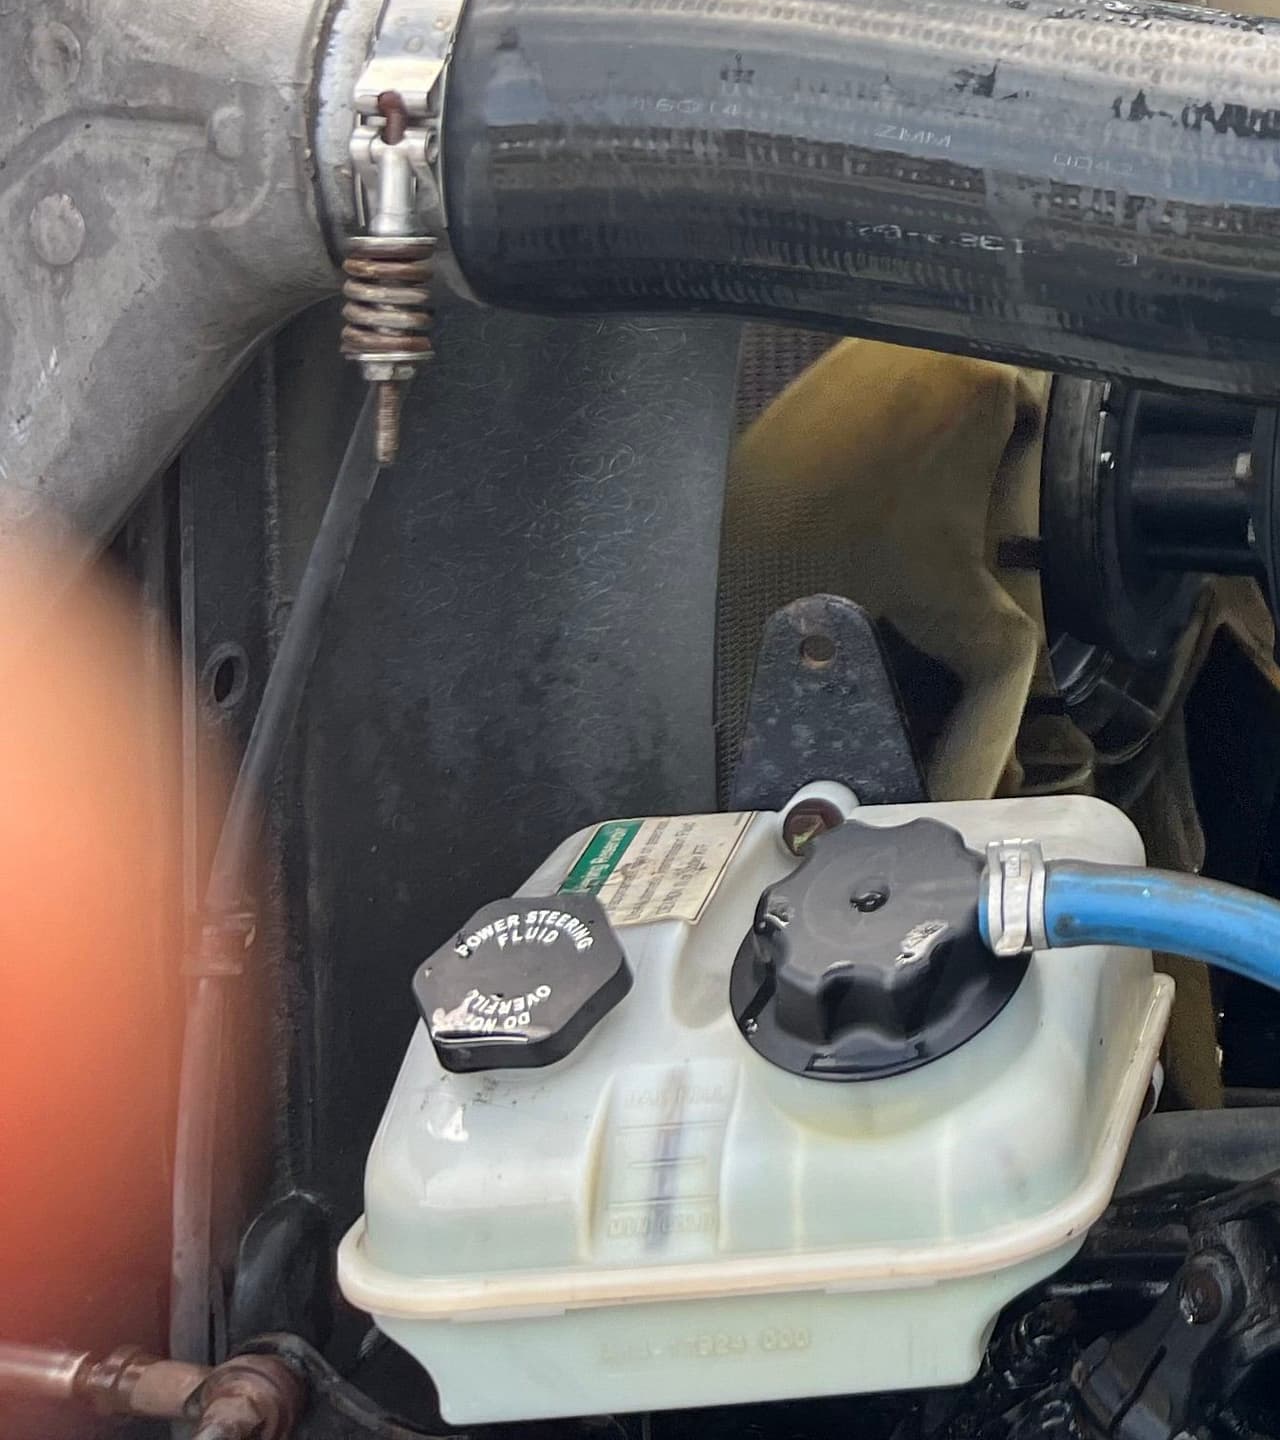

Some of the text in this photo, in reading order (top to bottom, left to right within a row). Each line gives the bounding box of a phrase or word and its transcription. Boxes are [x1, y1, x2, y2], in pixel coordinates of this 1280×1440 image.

[454, 909, 595, 958] POWER STEERING
[496, 925, 560, 950] FLUID
[502, 1011, 531, 1030] DO
